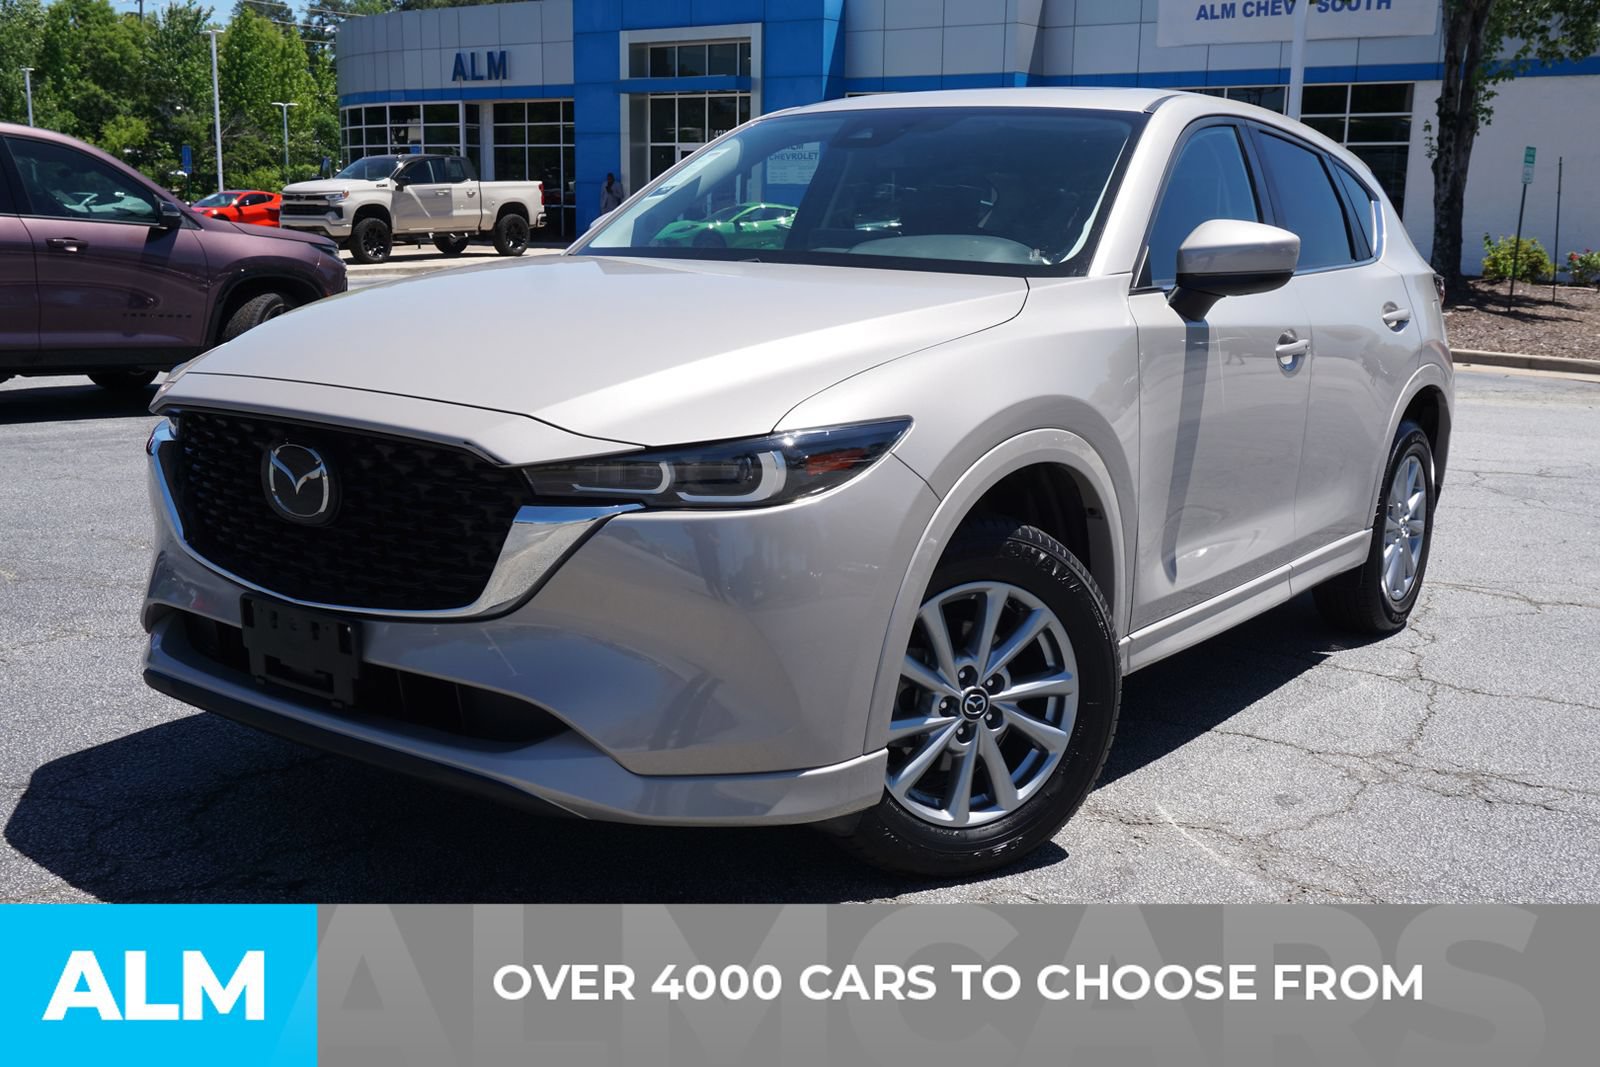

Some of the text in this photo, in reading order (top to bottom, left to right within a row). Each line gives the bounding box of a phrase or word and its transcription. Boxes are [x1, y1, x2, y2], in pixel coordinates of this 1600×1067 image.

[1196, 0, 1391, 20] ALM CHEV SOUTH
[452, 51, 507, 81] ALM
